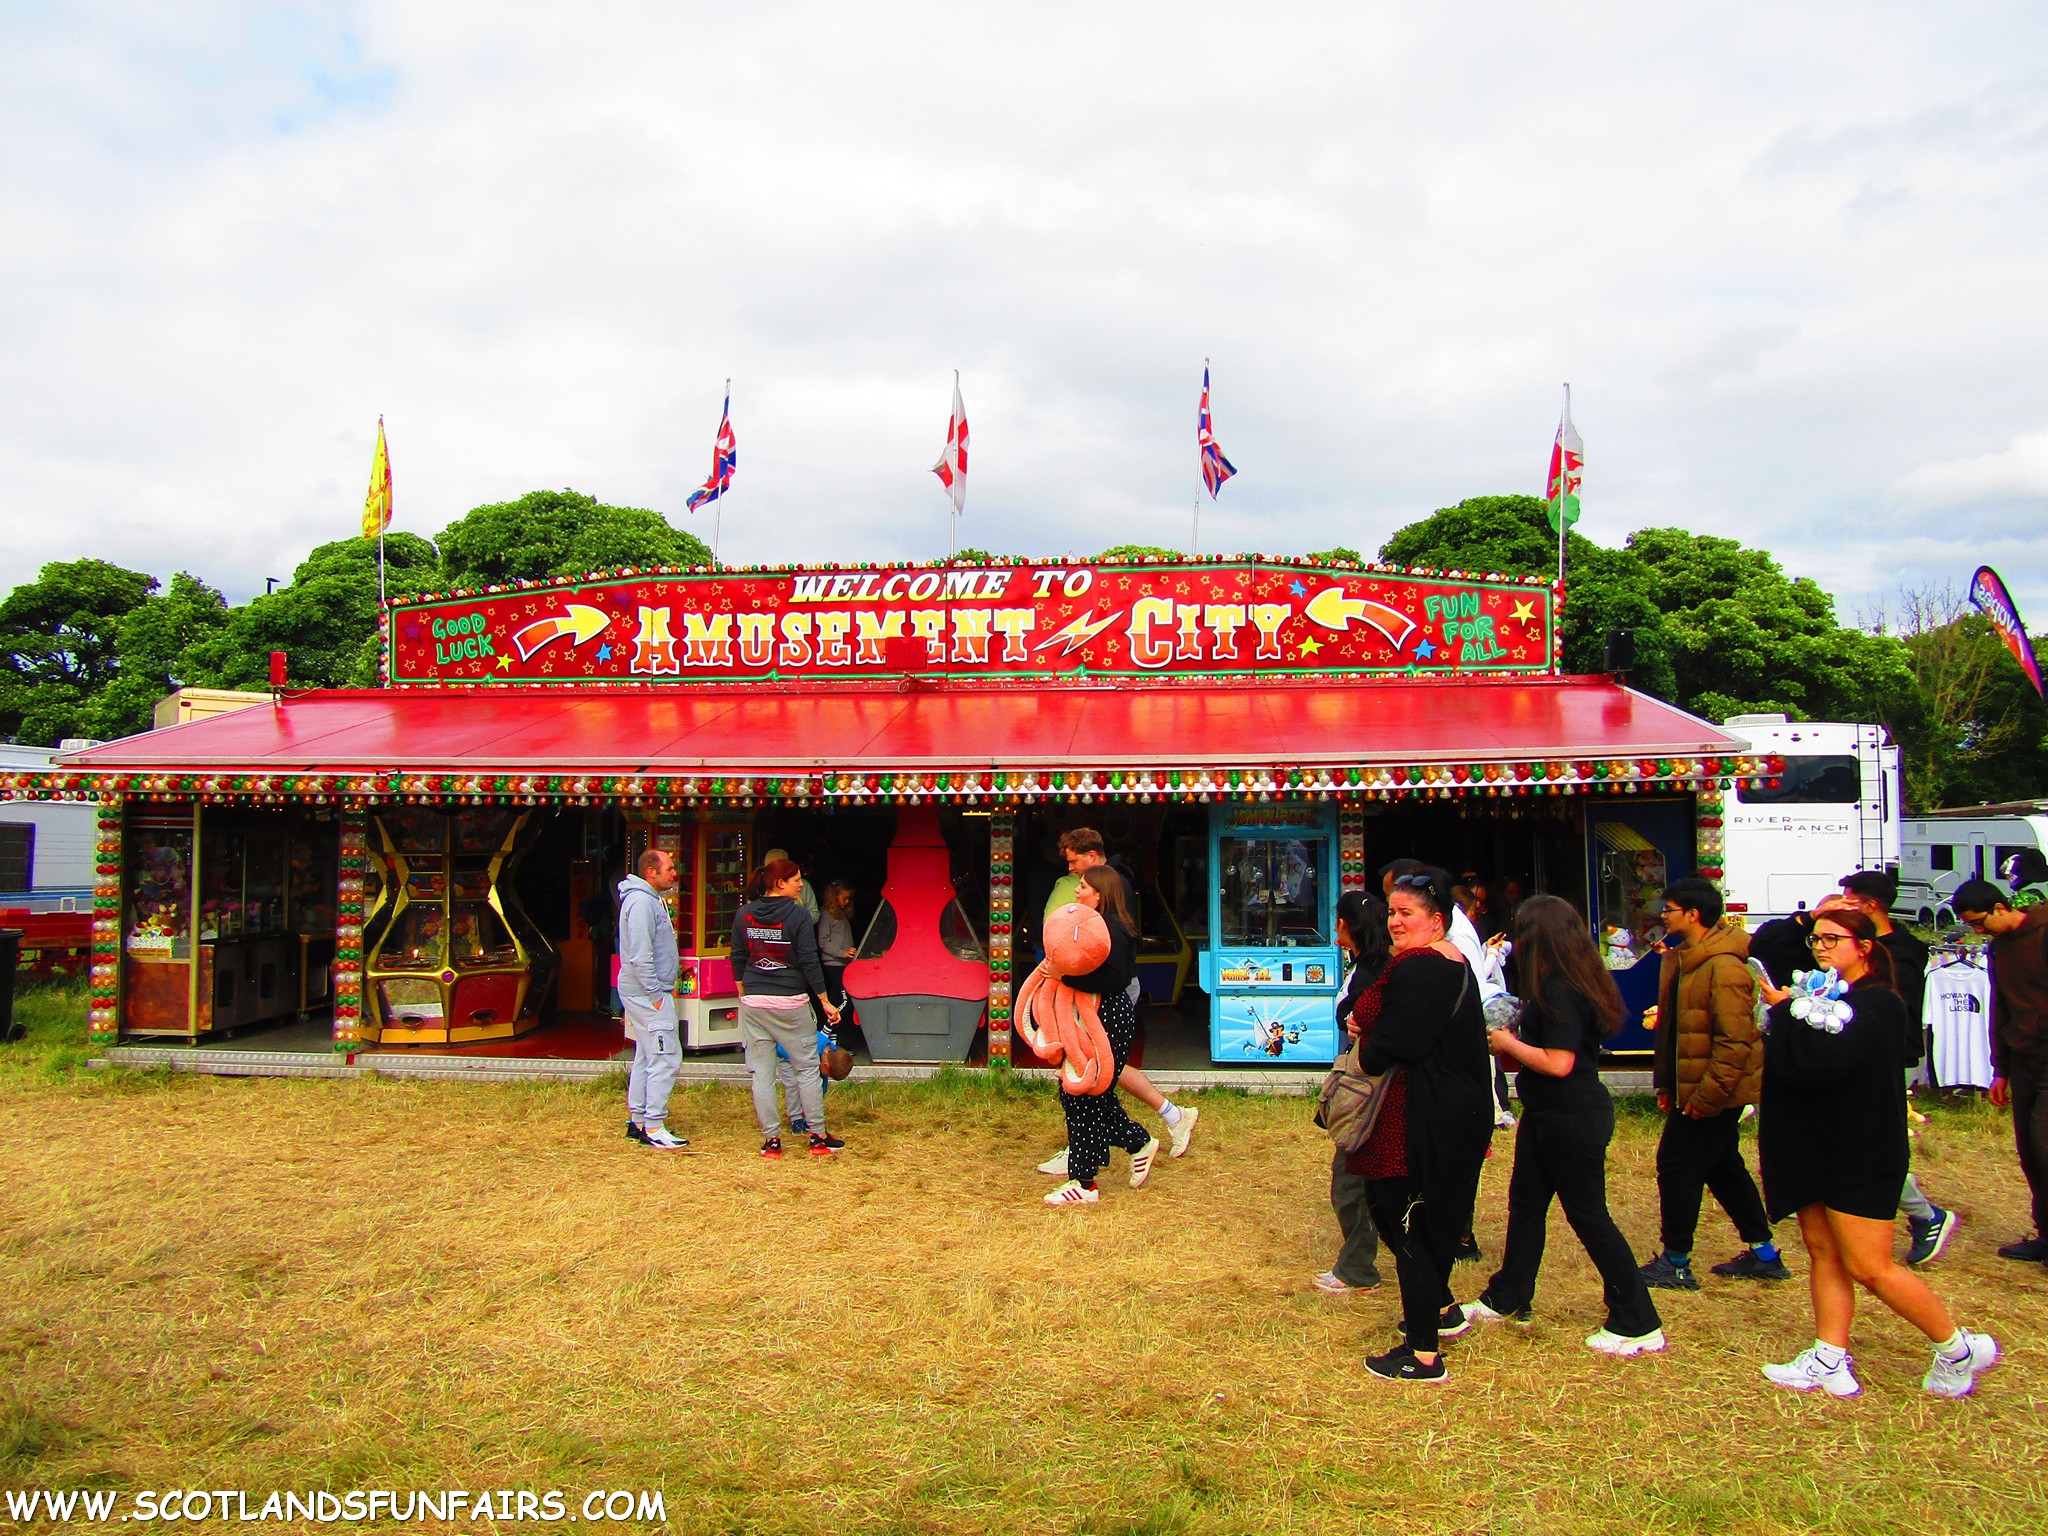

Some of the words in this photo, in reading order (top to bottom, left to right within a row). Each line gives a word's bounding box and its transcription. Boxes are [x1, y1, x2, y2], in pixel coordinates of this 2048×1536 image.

[788, 571, 1011, 602] WELCOME
[1032, 570, 1093, 598] TO
[1424, 592, 1479, 622] FUN
[432, 613, 486, 640] GOOD
[630, 606, 1036, 675] AMUSEMENT
[1124, 597, 1292, 668] CITY
[1442, 615, 1496, 645] FOR
[436, 634, 495, 664] LUCK
[1461, 639, 1507, 662] ALL
[1940, 992, 1969, 1000] HOWAY
